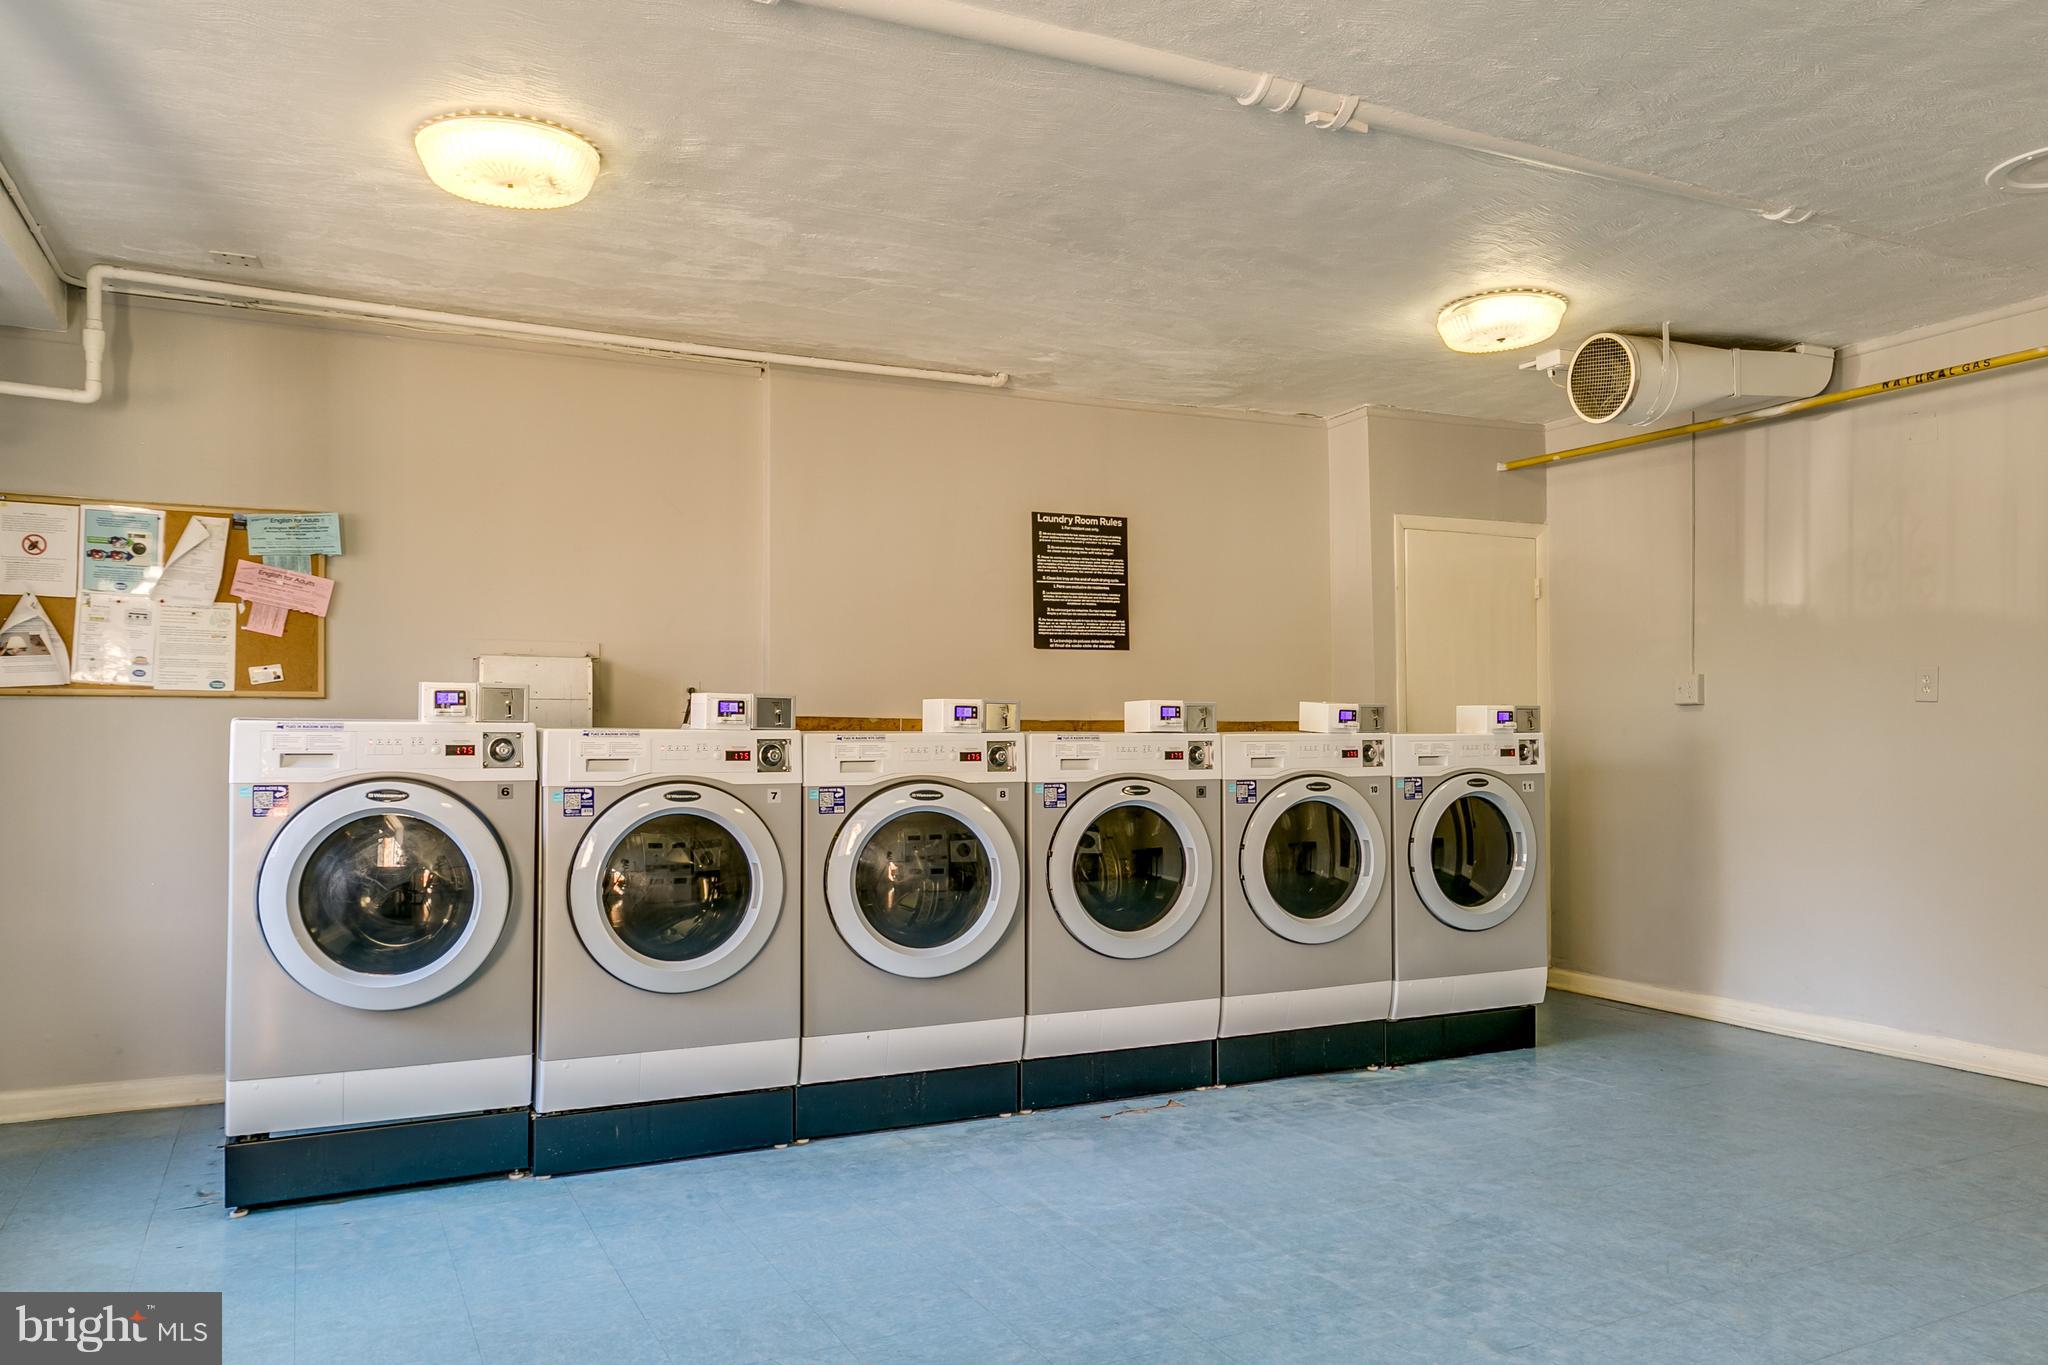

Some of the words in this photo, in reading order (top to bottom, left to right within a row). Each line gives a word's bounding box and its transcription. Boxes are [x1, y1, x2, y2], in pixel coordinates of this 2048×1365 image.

[1882, 367, 1955, 389] NATURAL
[1962, 359, 1991, 372] GAS
[1037, 514, 1073, 525] Laundry
[1075, 516, 1098, 525] Room
[1100, 518, 1122, 527] Rules
[258, 570, 282, 579] English
[294, 578, 315, 587] Adults
[501, 787, 510, 796] 6
[770, 791, 778, 800] 7
[1000, 790, 1006, 798] 8
[1198, 788, 1204, 796] 9
